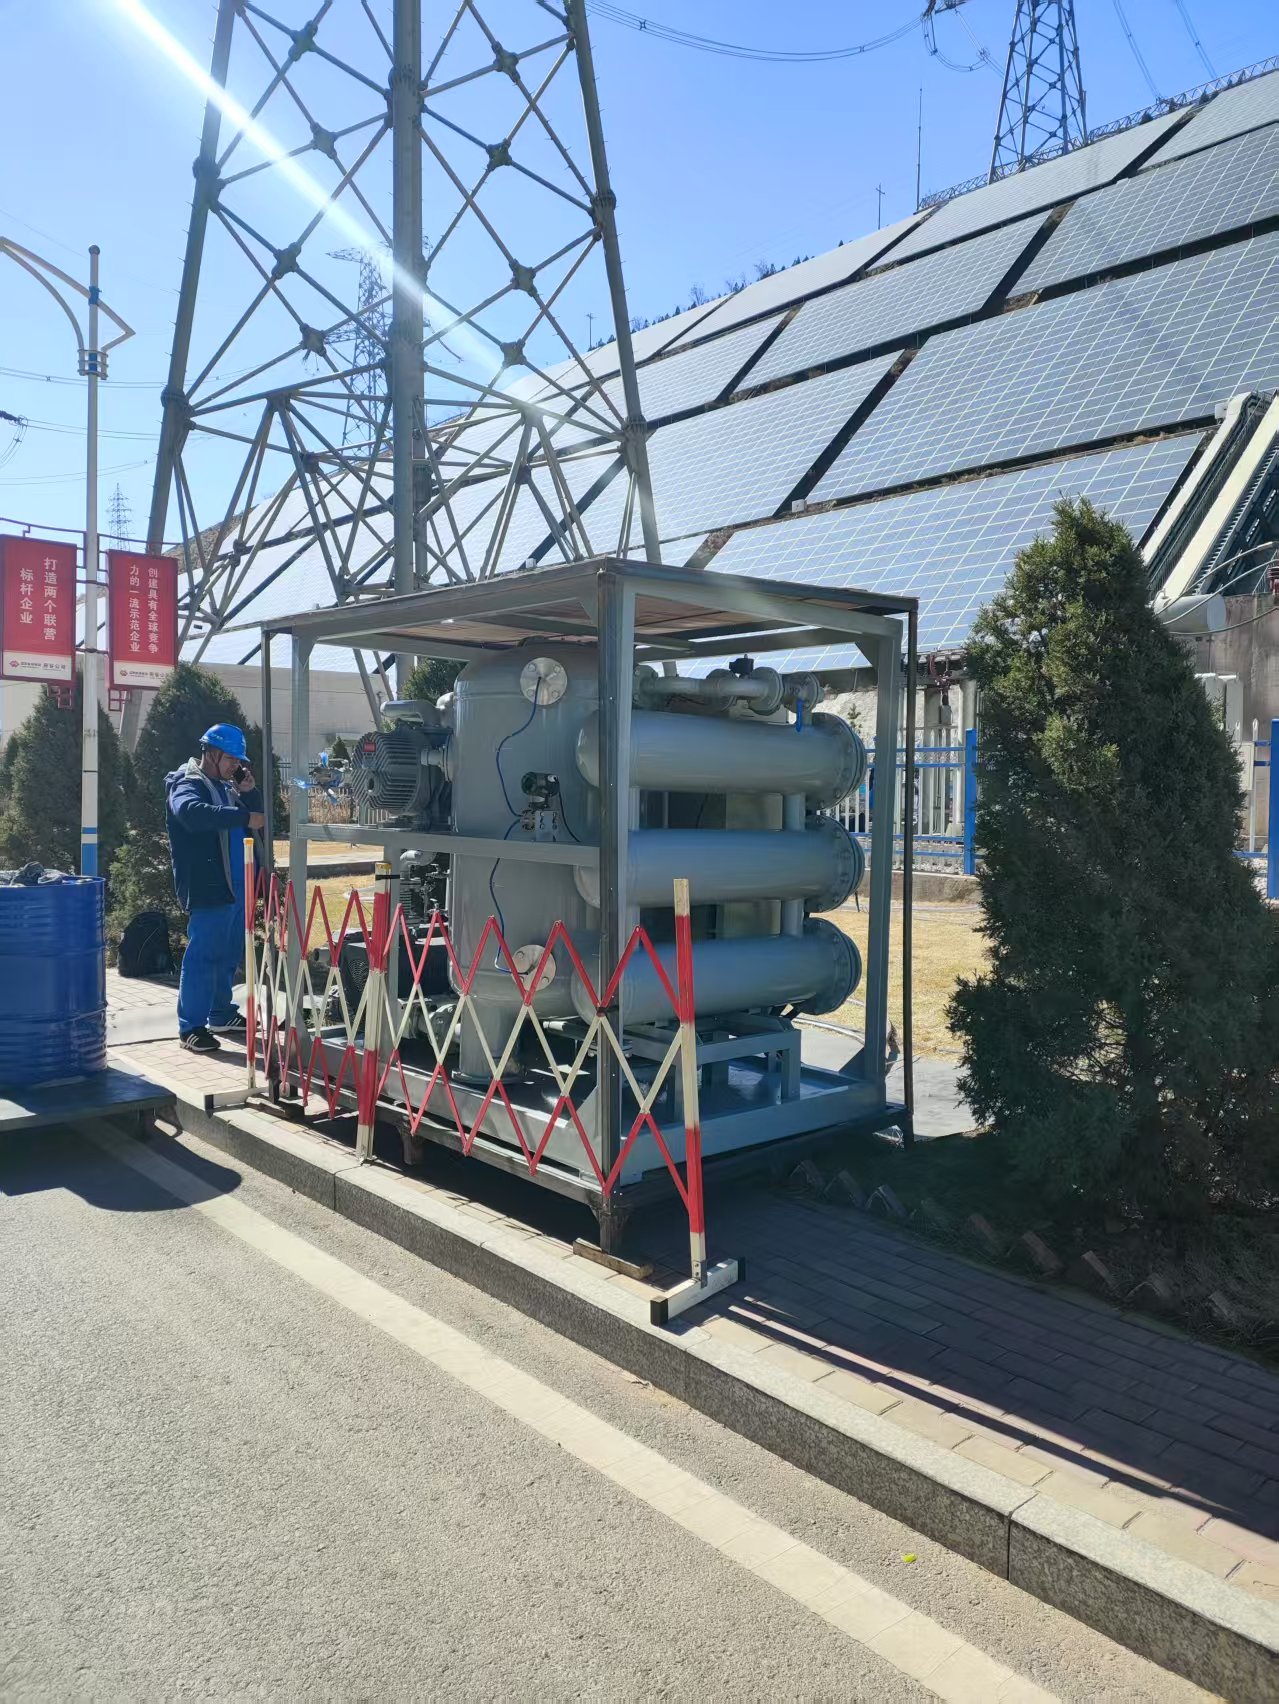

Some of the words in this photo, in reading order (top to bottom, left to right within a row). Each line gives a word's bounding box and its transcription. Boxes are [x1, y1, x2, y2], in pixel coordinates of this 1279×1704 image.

[20, 567, 34, 624] 标杆企业
[43, 557, 57, 640] 打造两个联营
[129, 565, 140, 652] 力的一流示范企业
[148, 568, 158, 653] 创建具有全球竞争
